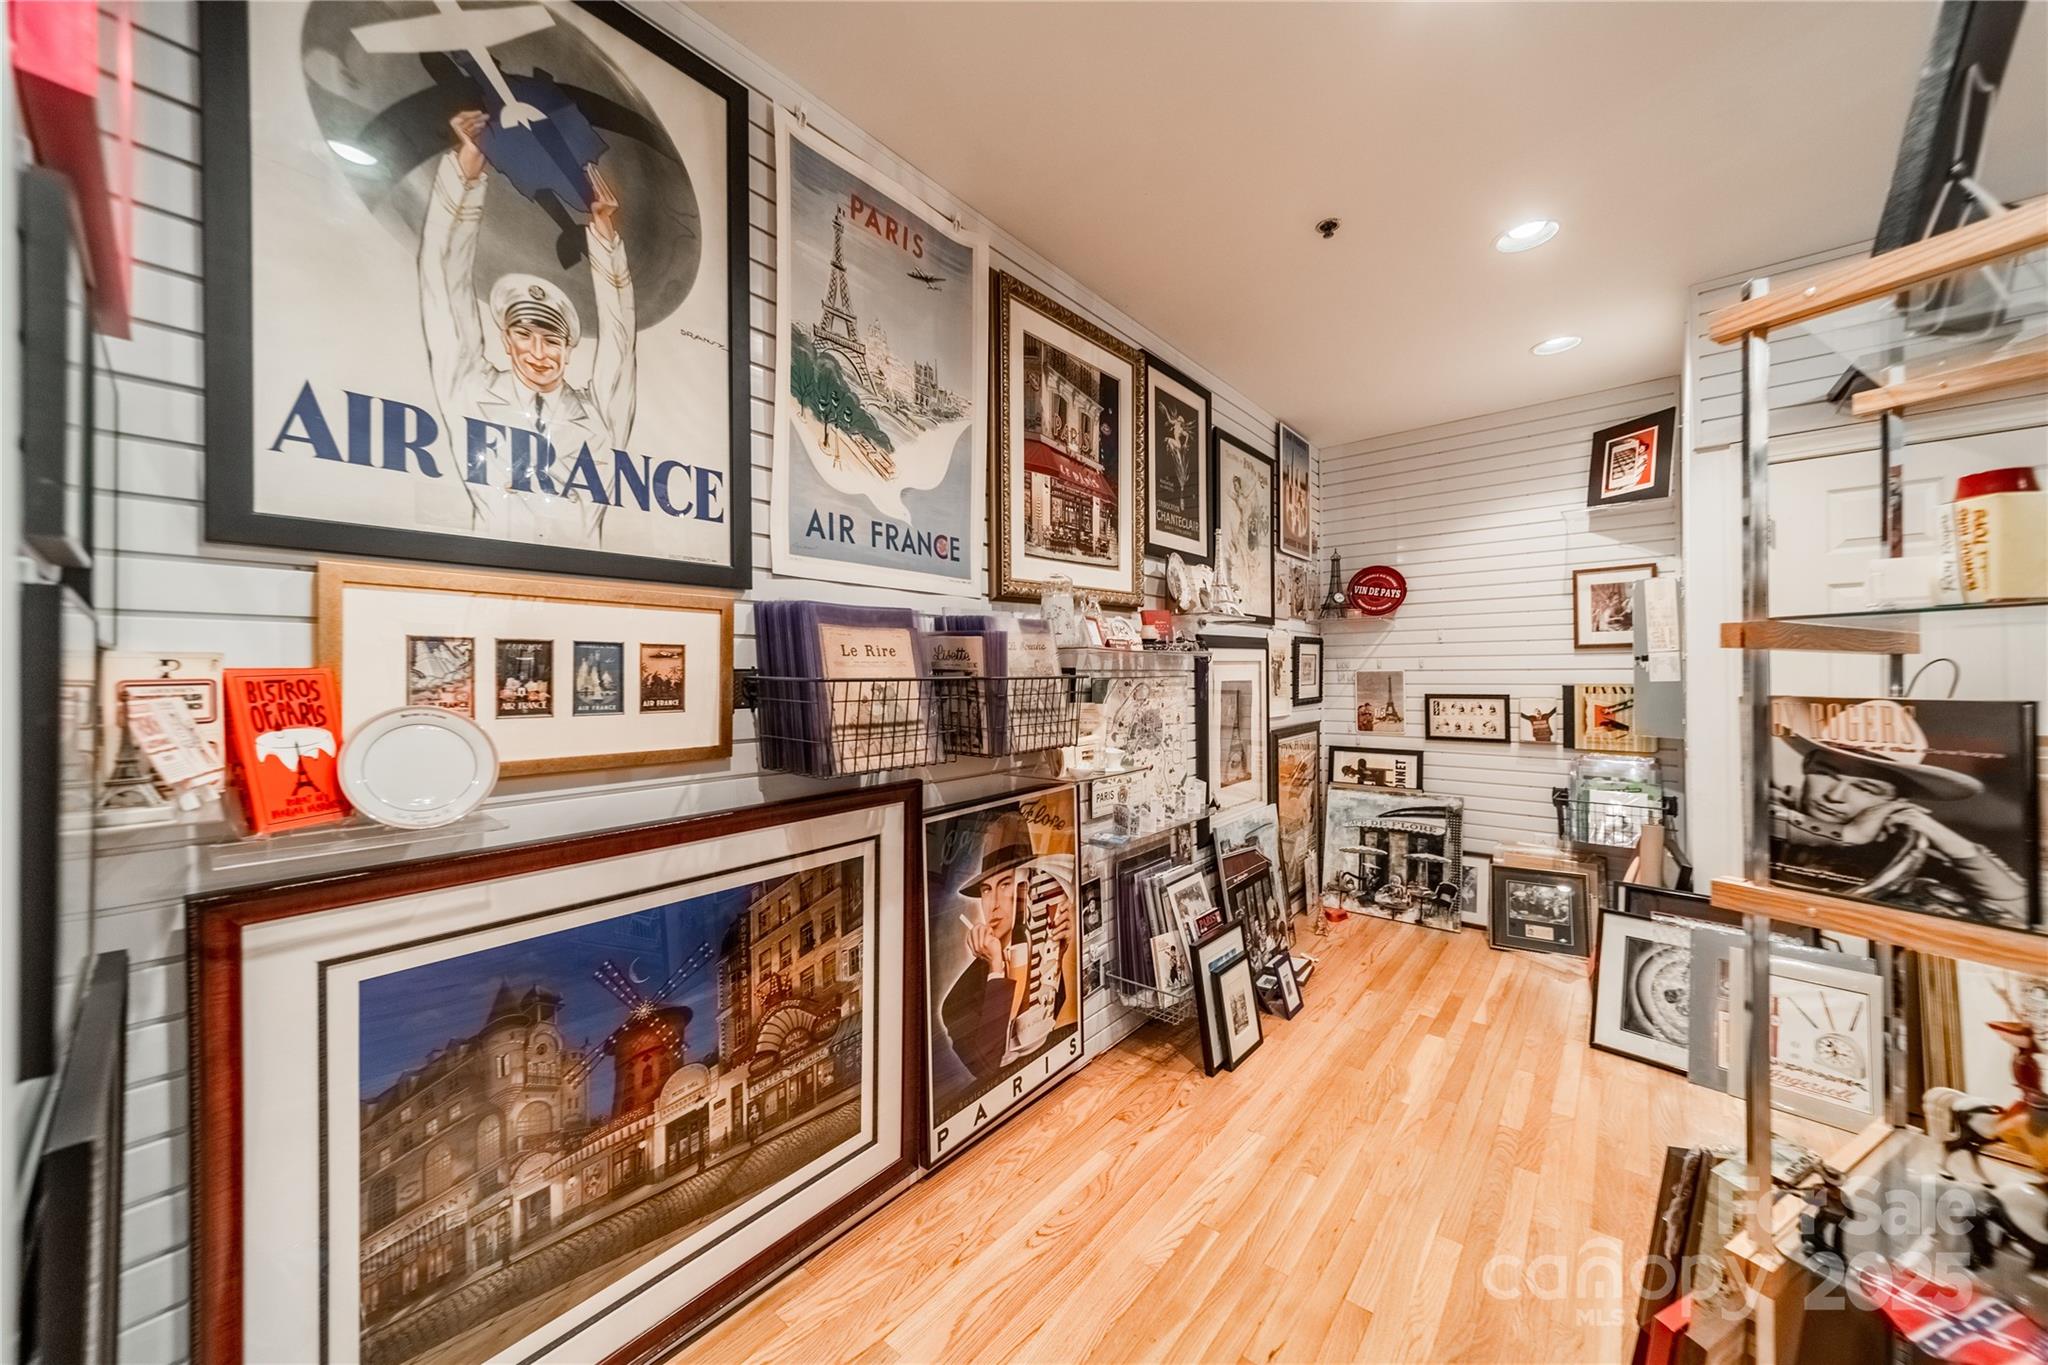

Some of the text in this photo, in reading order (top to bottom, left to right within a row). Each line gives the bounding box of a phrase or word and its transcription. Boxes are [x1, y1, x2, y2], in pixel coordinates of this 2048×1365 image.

[850, 193, 924, 259] PARIS
[269, 379, 724, 524] AIR FRANCE
[805, 508, 960, 563] AIR FRANCE
[1354, 585, 1402, 598] VIN DE PAYS
[841, 644, 897, 658] Le Rire
[245, 679, 321, 704] BISTROS
[655, 699, 680, 707] FRANCE
[250, 701, 328, 733] OF PARIS
[577, 704, 590, 712] AIR
[1809, 702, 1918, 745] ROGERS
[1096, 789, 1115, 804] PARIS
[937, 1037, 1077, 1153] PARIS
